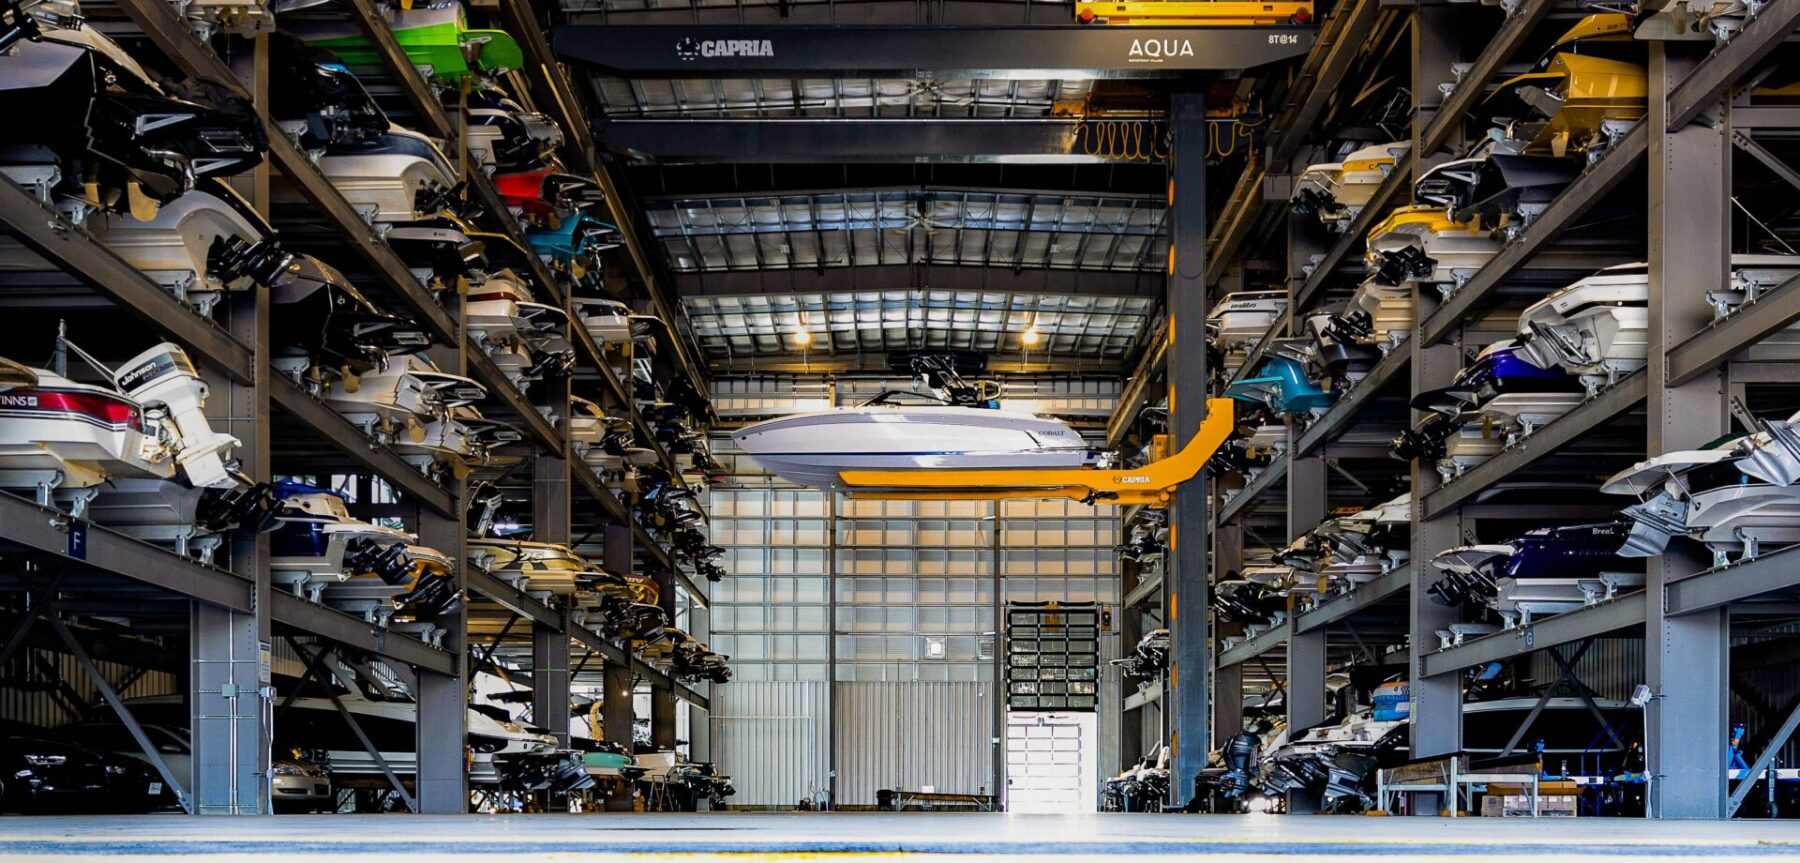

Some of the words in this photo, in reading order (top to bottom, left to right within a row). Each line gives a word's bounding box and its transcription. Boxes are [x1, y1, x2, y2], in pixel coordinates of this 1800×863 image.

[701, 40, 774, 57] CAPRIA
[1129, 39, 1194, 57] AQUA
[121, 362, 156, 386] Johnson
[0, 395, 27, 406] INNS
[1121, 476, 1150, 484] CAPRIA
[73, 531, 81, 550] F
[1526, 632, 1533, 646] G
